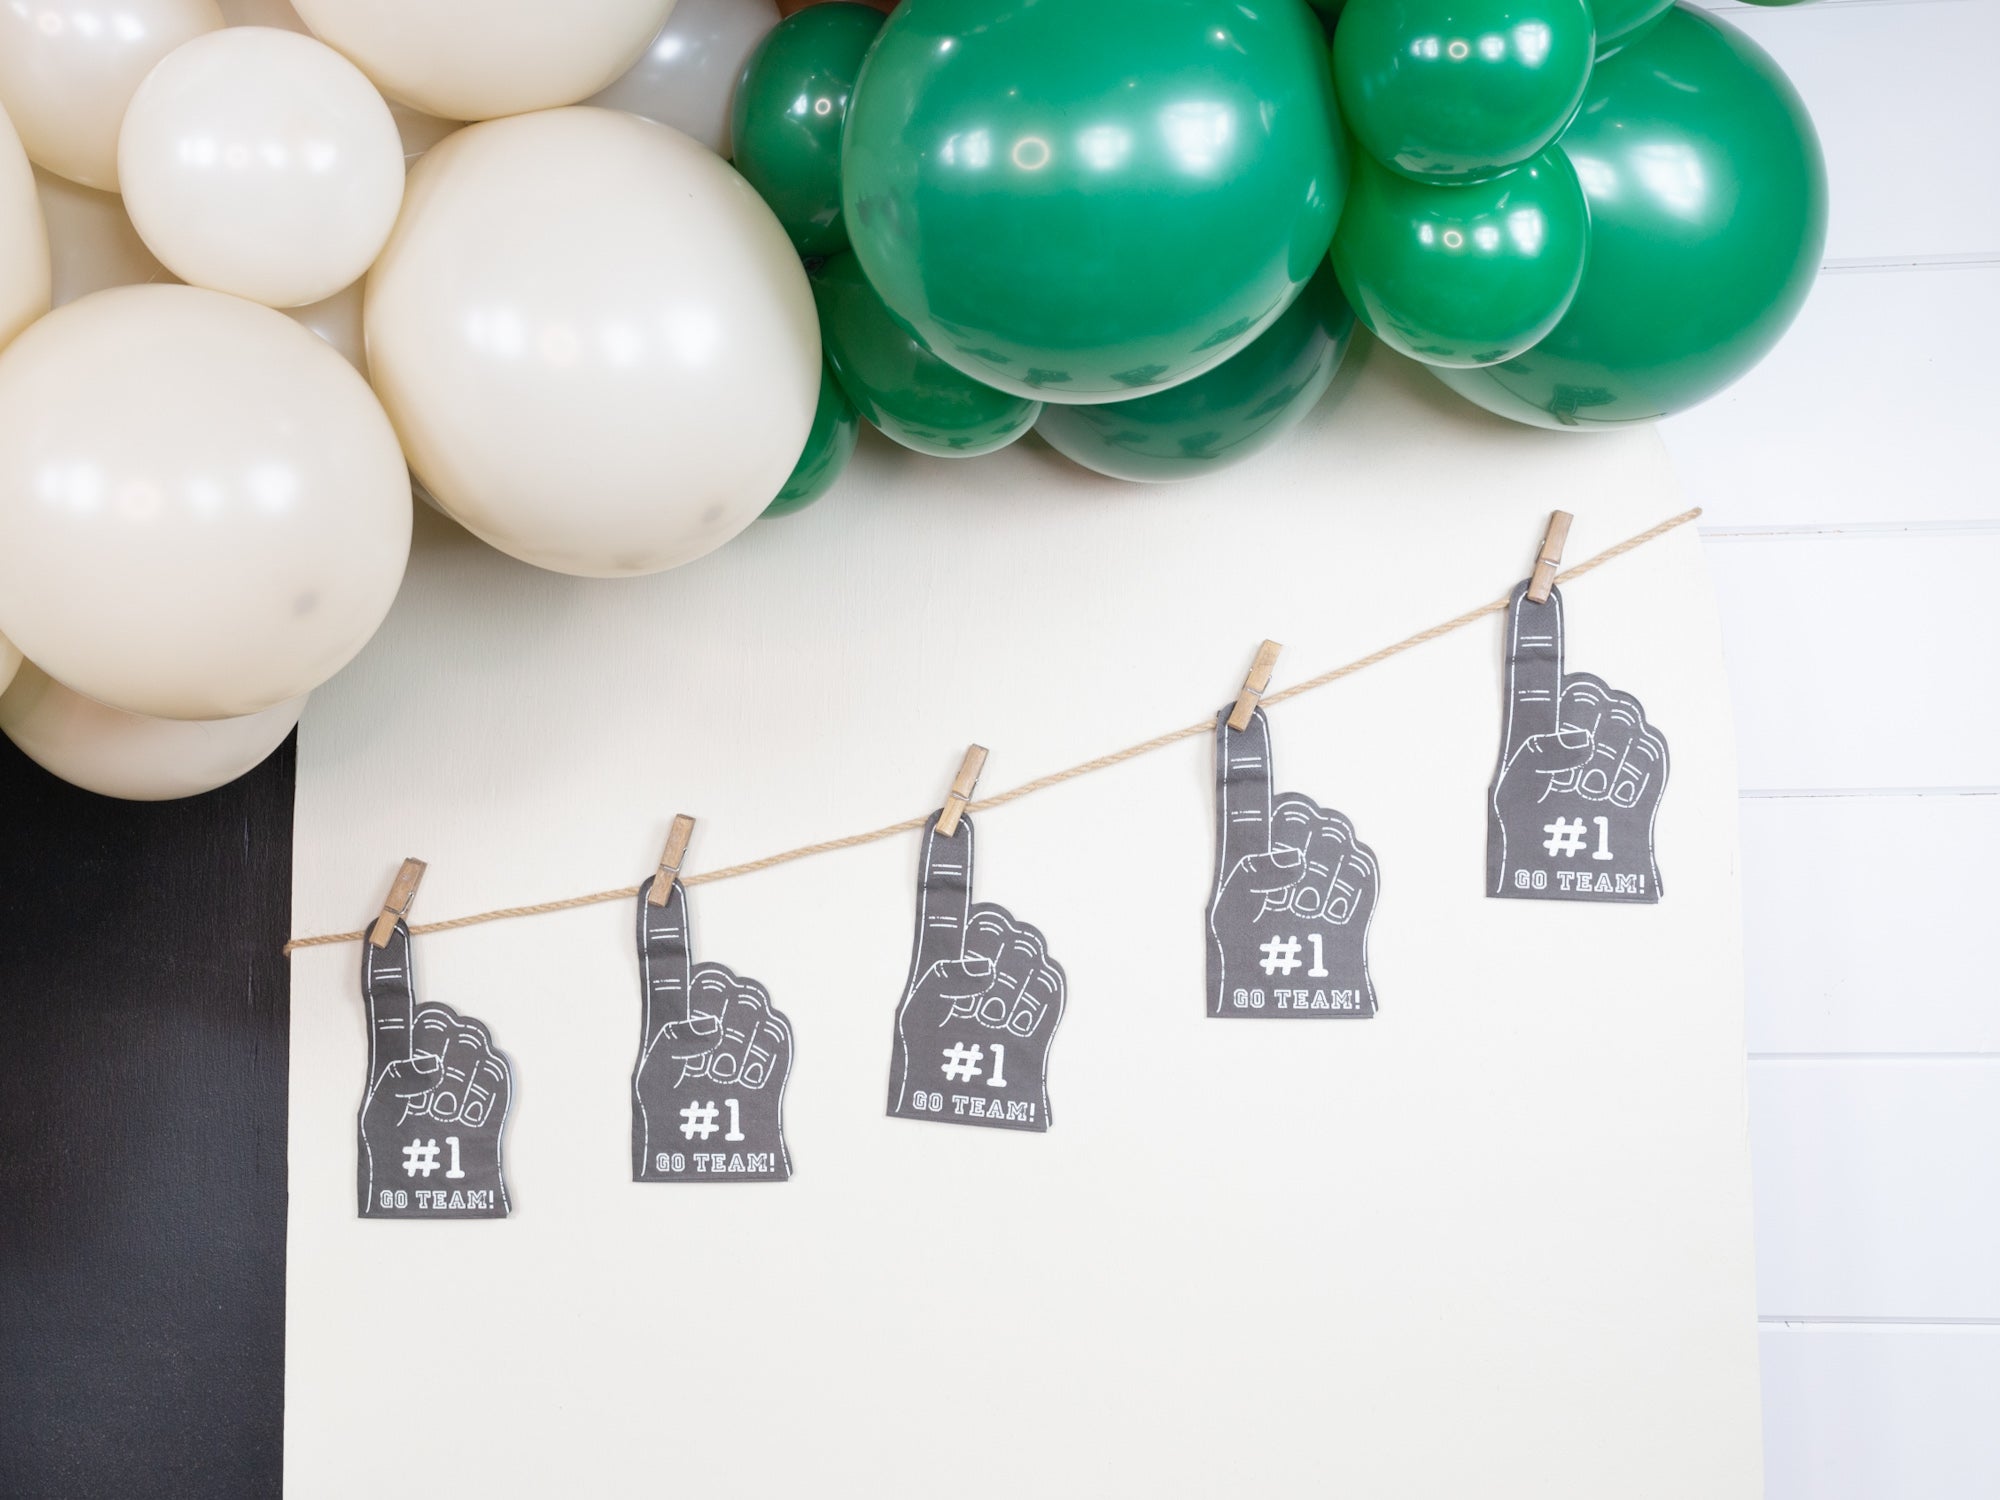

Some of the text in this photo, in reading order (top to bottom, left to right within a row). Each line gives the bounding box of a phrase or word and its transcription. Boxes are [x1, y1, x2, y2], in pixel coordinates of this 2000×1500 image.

[1543, 816, 1614, 860] #1
[1515, 869, 1645, 894] GO TEAM!
[1259, 933, 1329, 977] #1
[1233, 988, 1361, 1010] GO TEAM!
[941, 1041, 1007, 1088] #1
[679, 1098, 745, 1141] #1
[912, 1090, 1036, 1122] GO TEAM!
[402, 1136, 465, 1179] #1
[656, 1152, 776, 1173] GO TEAM!
[380, 1189, 495, 1210] GO TEAM!
